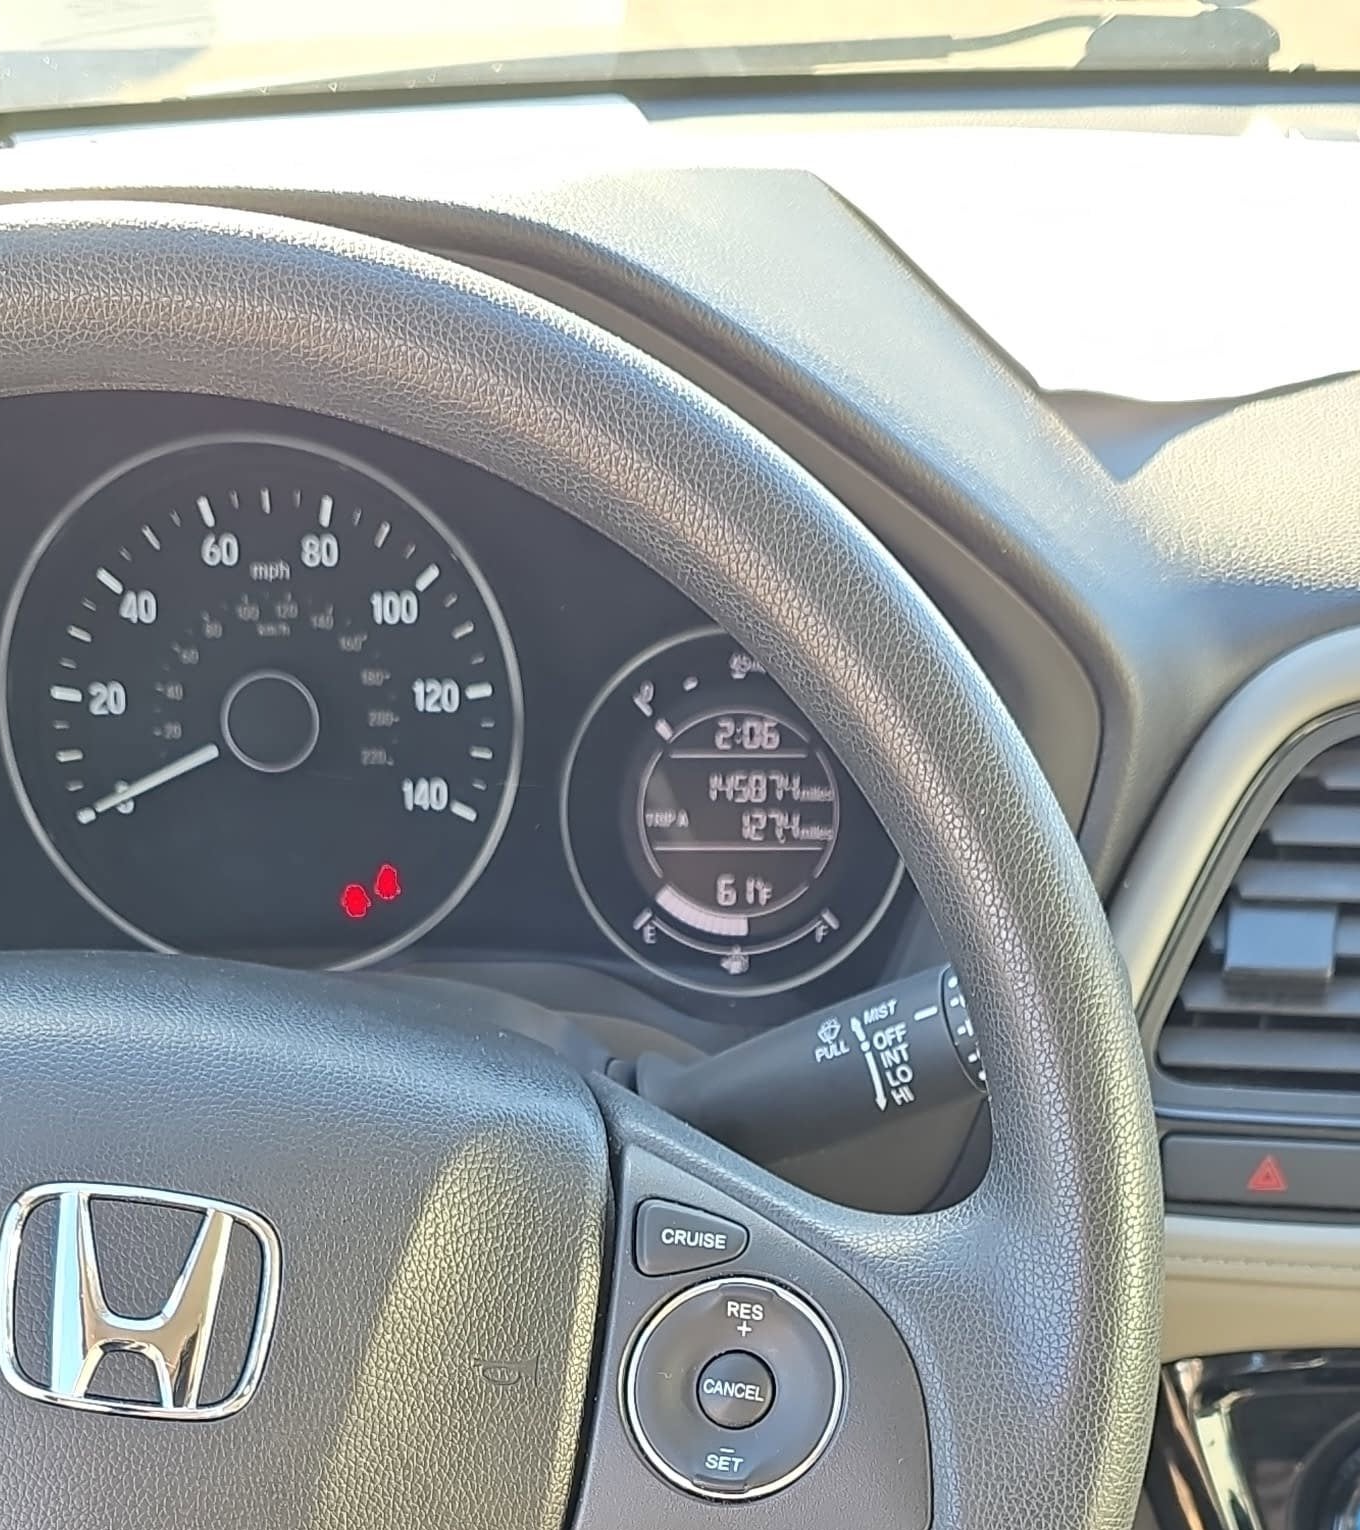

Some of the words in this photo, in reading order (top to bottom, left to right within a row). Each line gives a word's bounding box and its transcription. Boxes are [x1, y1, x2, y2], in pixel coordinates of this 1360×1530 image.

[202, 533, 239, 568] 60
[301, 533, 339, 568] 80
[251, 561, 291, 582] mph
[119, 590, 157, 625] 40
[371, 590, 419, 625] 100
[89, 681, 127, 716] 20
[413, 678, 460, 713] 120
[714, 718, 781, 750] 2:06
[403, 777, 449, 812] 140
[708, 772, 800, 803] 145874
[643, 924, 657, 944] E
[815, 924, 829, 944] F
[863, 999, 898, 1025] MIST
[872, 1021, 907, 1050] OFF
[814, 1040, 850, 1063] PULL
[879, 1043, 910, 1069] INT
[885, 1064, 913, 1087] LO
[890, 1085, 916, 1106] HI
[661, 1228, 727, 1250] CRUISE
[727, 1301, 764, 1321] RES
[703, 1378, 764, 1402] CANCEL
[705, 1453, 744, 1473] SET
